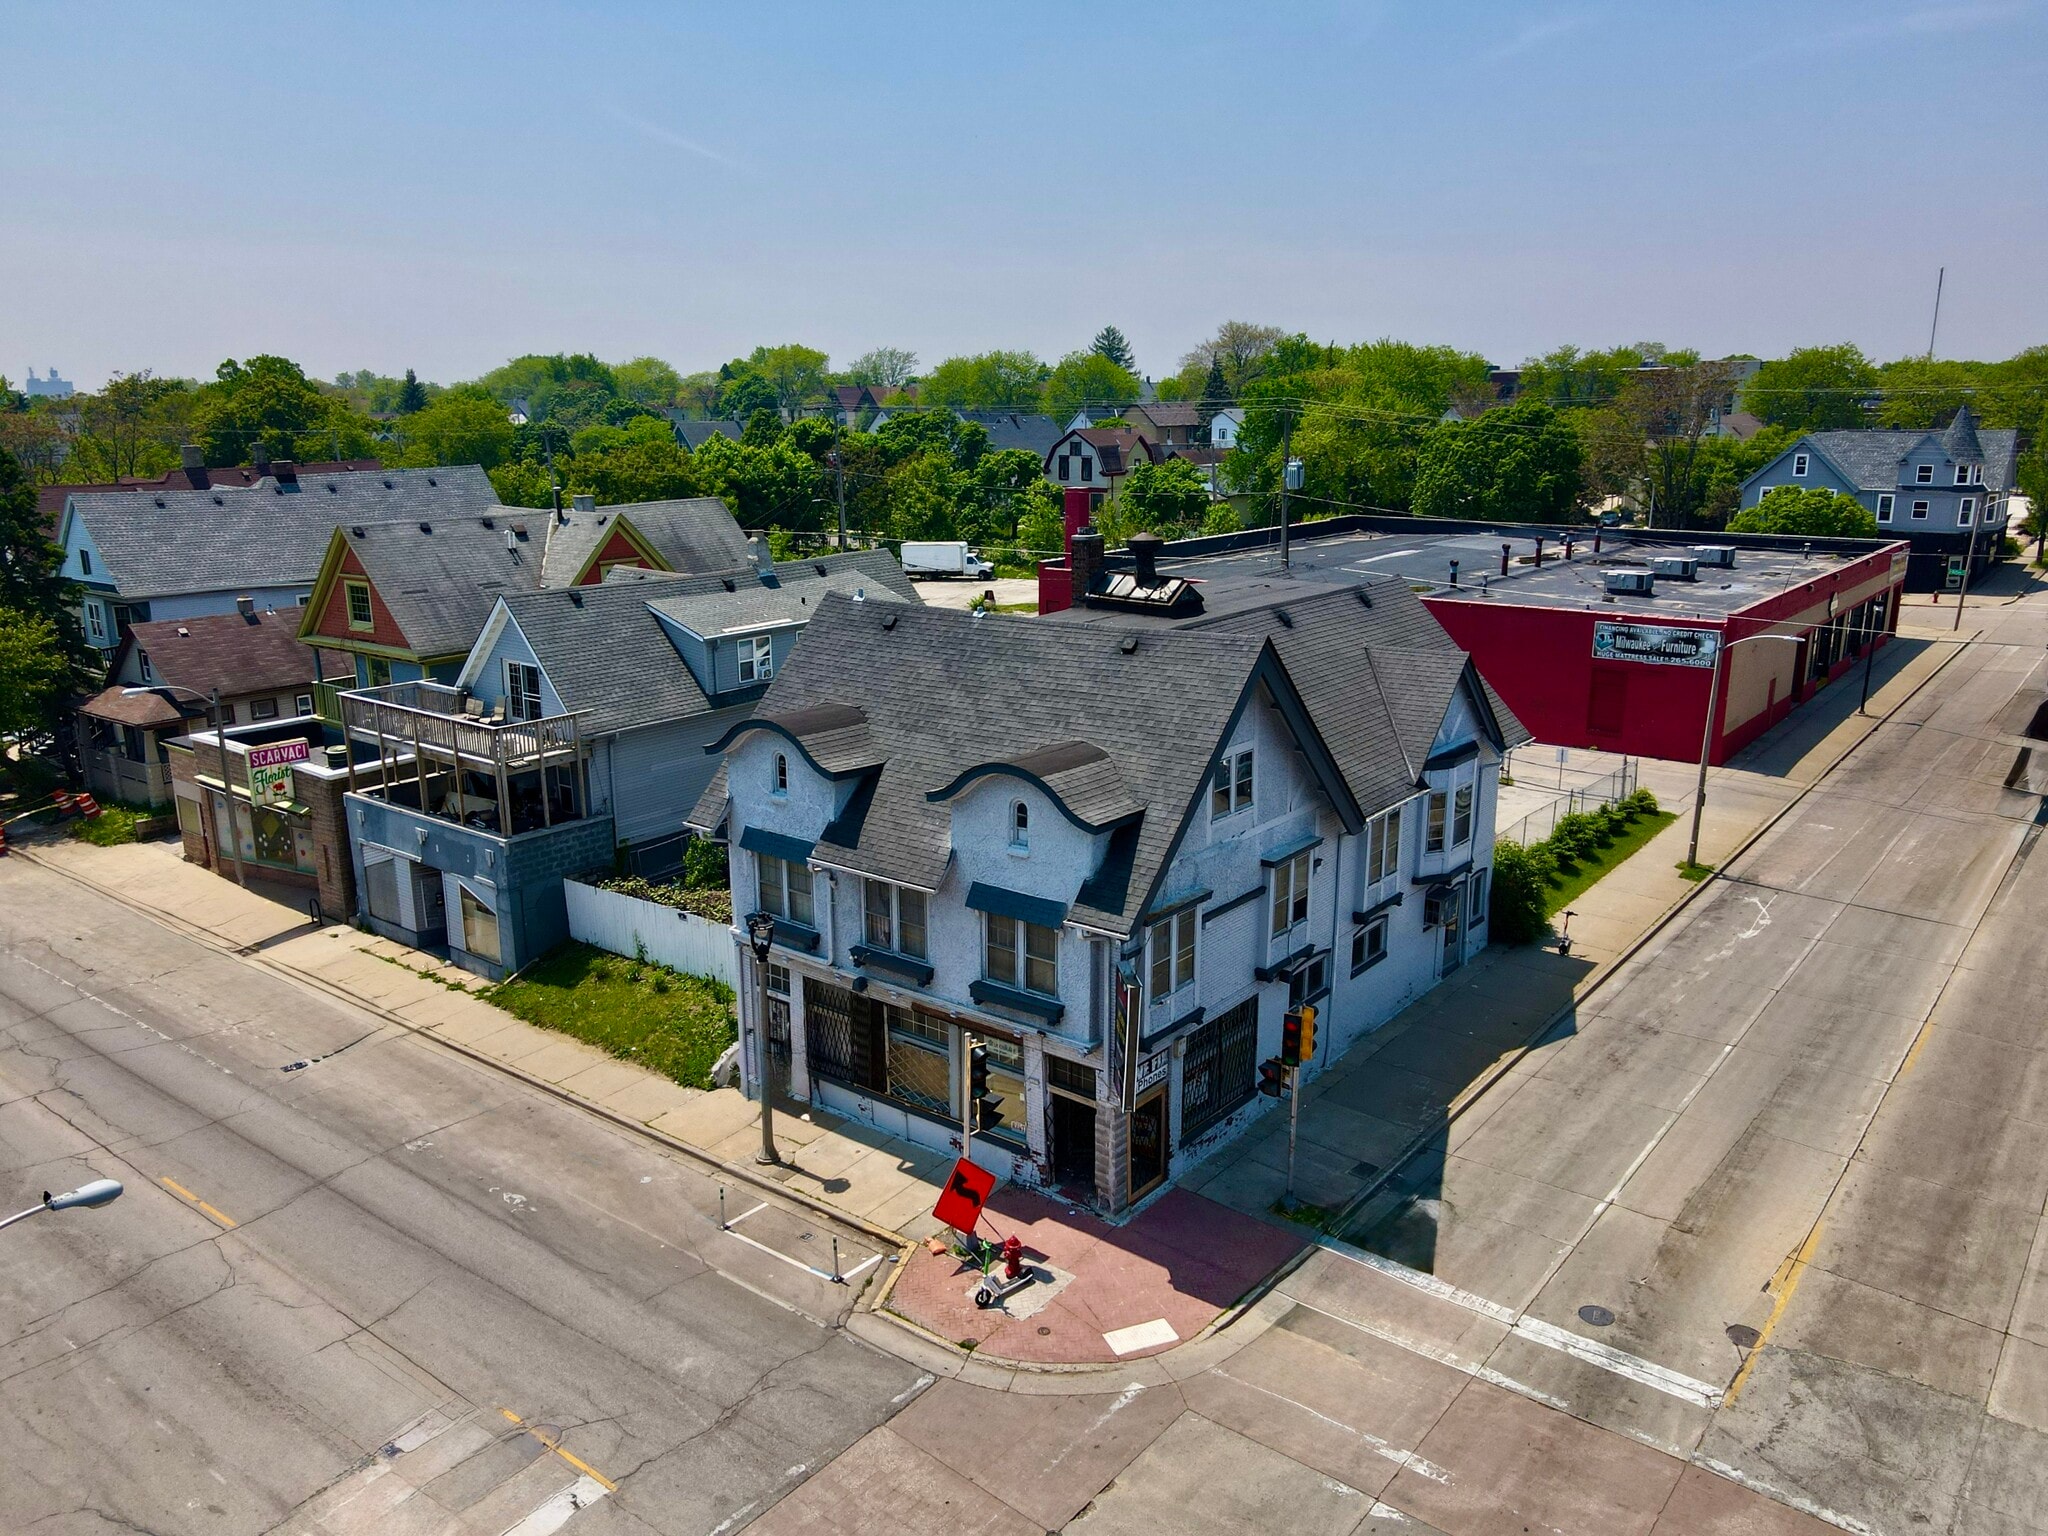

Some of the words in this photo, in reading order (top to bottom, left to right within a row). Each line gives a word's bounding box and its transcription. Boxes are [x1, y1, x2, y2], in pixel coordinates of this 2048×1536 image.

[1616, 635, 1651, 650] Milwaukee
[1661, 639, 1697, 655] Furniture
[1673, 630, 1693, 638] CREDIT
[252, 744, 306, 766] SCARVACI
[253, 766, 291, 796] Florist
[1138, 1067, 1167, 1090] Phones
